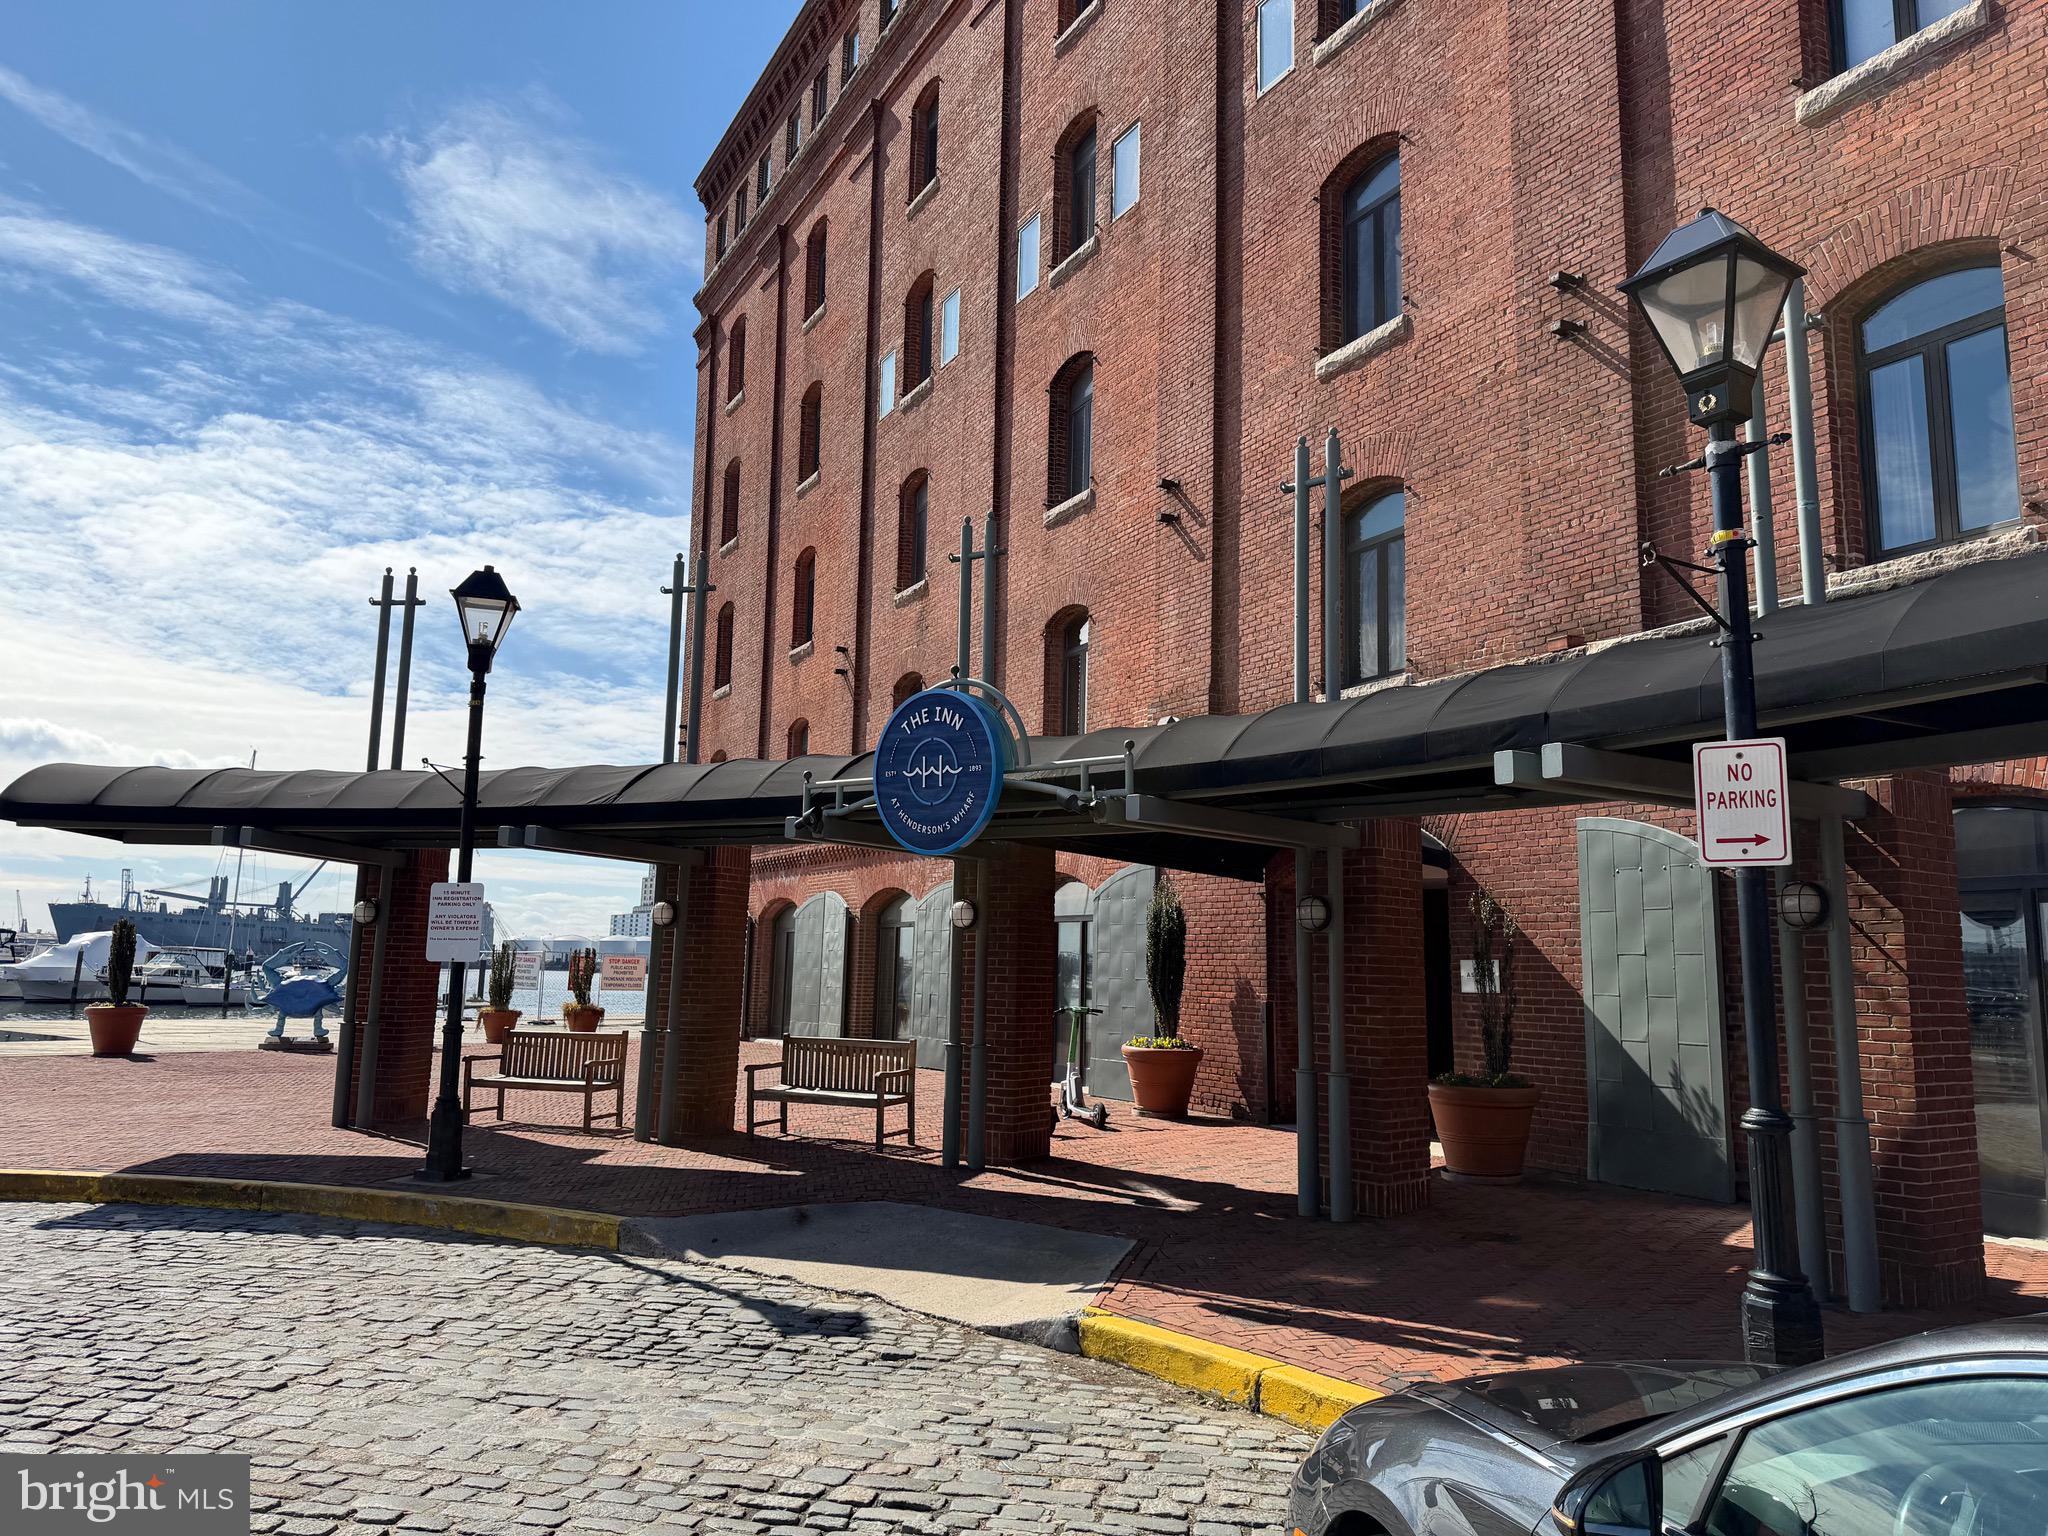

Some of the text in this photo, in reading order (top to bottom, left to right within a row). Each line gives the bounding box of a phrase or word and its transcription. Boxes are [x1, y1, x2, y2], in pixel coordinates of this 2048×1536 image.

[900, 706, 964, 735] THE INN
[1727, 763, 1752, 782] NO
[1707, 789, 1777, 810] PARKING
[891, 790, 976, 835] AT HENDERSON'S WHARF
